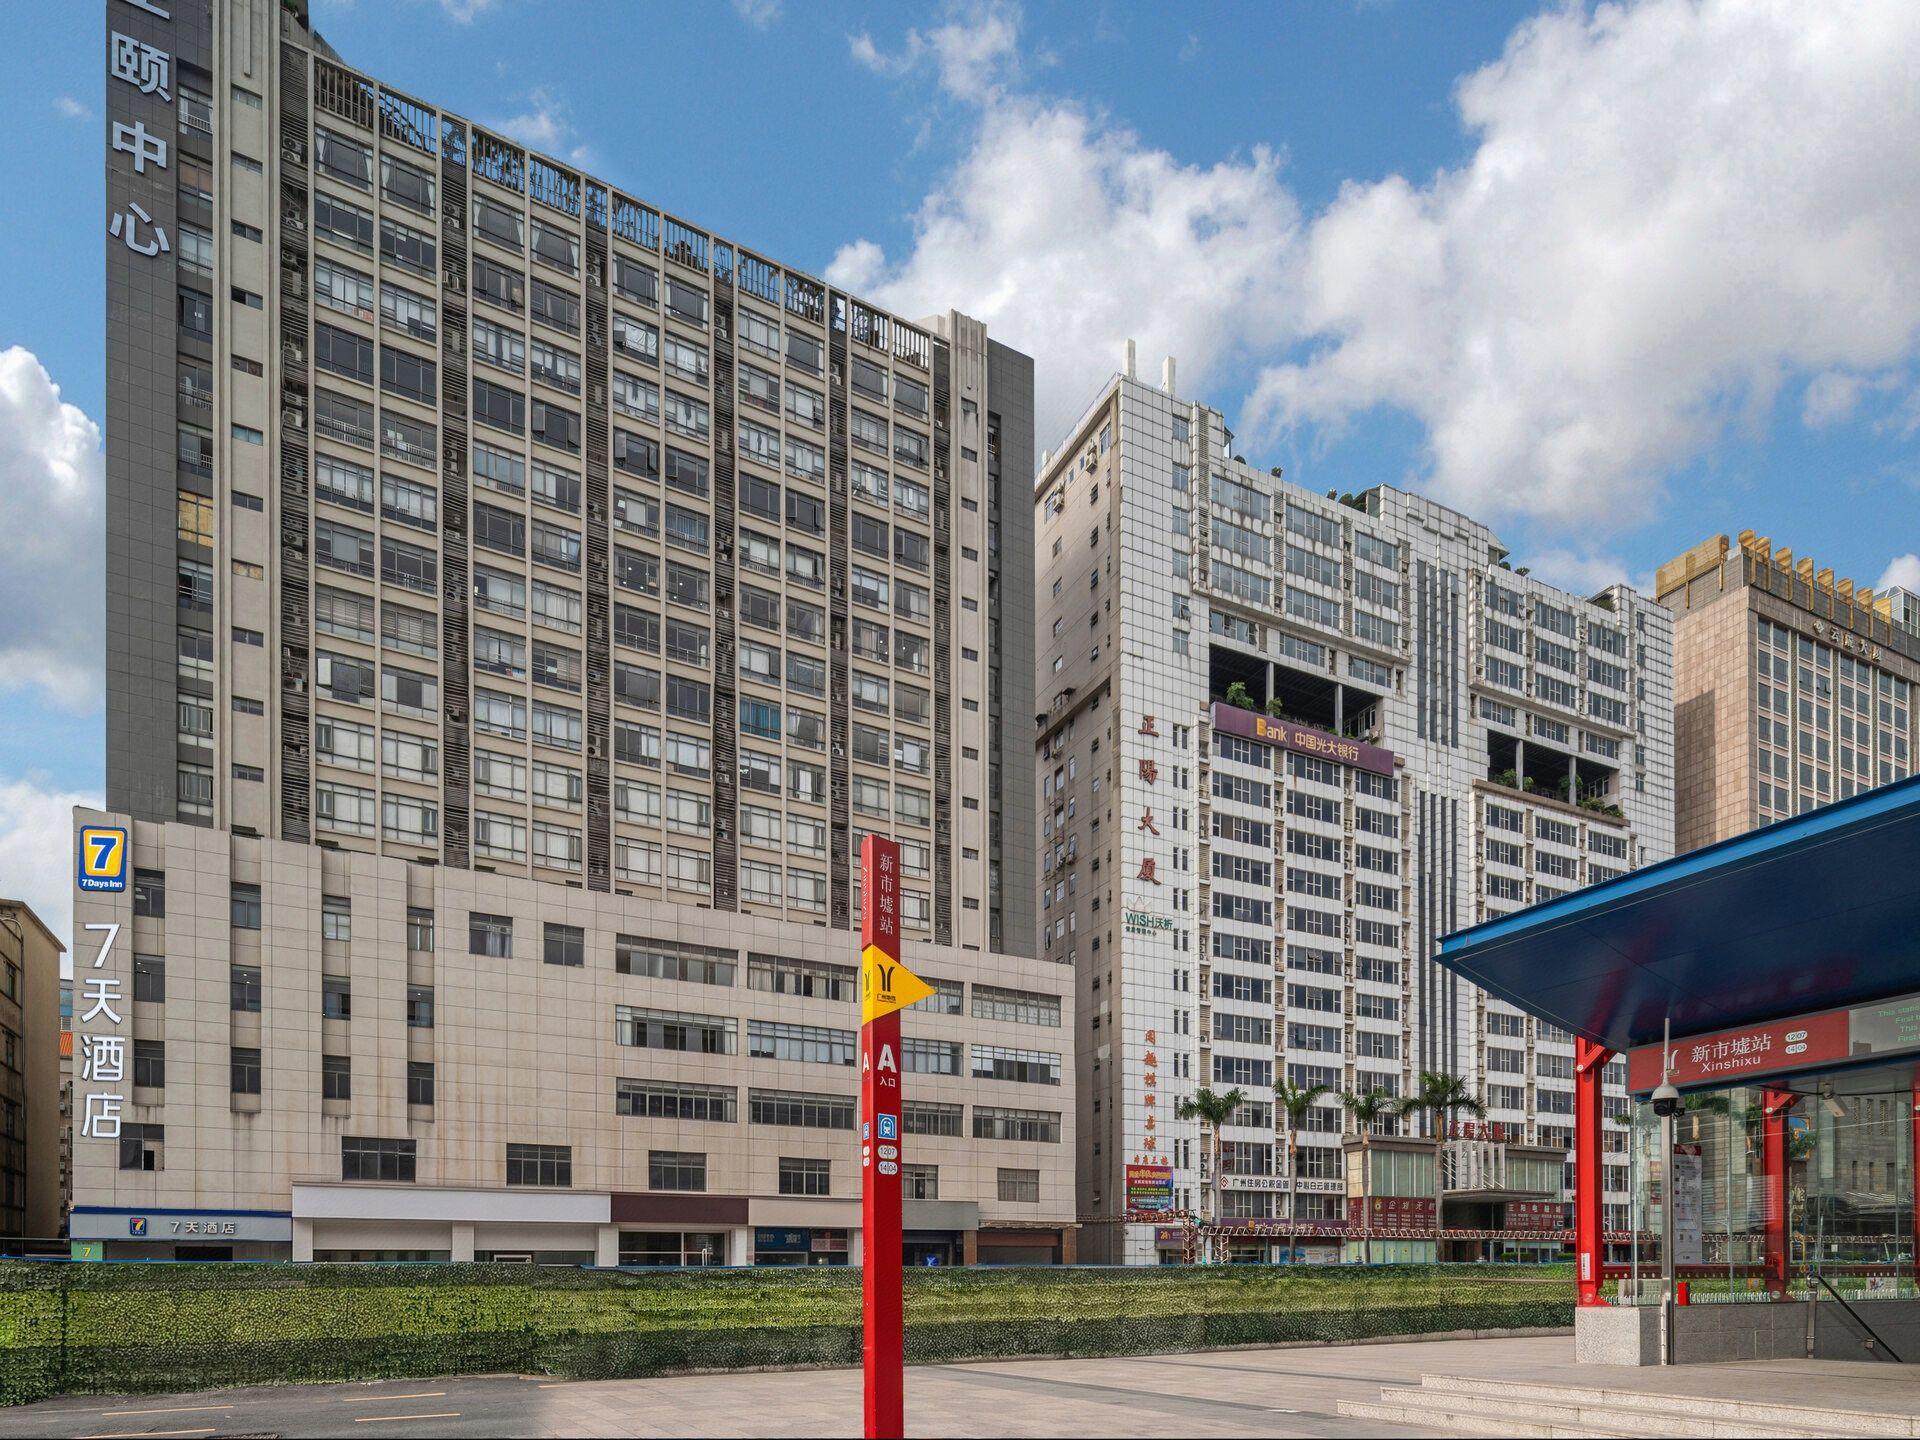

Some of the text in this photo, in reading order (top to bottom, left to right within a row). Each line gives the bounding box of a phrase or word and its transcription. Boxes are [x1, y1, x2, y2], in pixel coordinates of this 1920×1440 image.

[1256, 718, 1359, 761] Bank 中国光大银行
[89, 835, 118, 870] 7
[879, 853, 894, 935] 新市墟站
[81, 923, 125, 1139] 7天酒店
[862, 1052, 870, 1073] A
[877, 1043, 897, 1073] A
[1691, 1033, 1771, 1063] 新市墟站
[1701, 1055, 1761, 1073] Xinshixu
[879, 1076, 896, 1087] 入口
[1232, 1178, 1344, 1191] 广州住房公积金管中心白云管理部
[170, 1221, 236, 1234] 7天酒店
